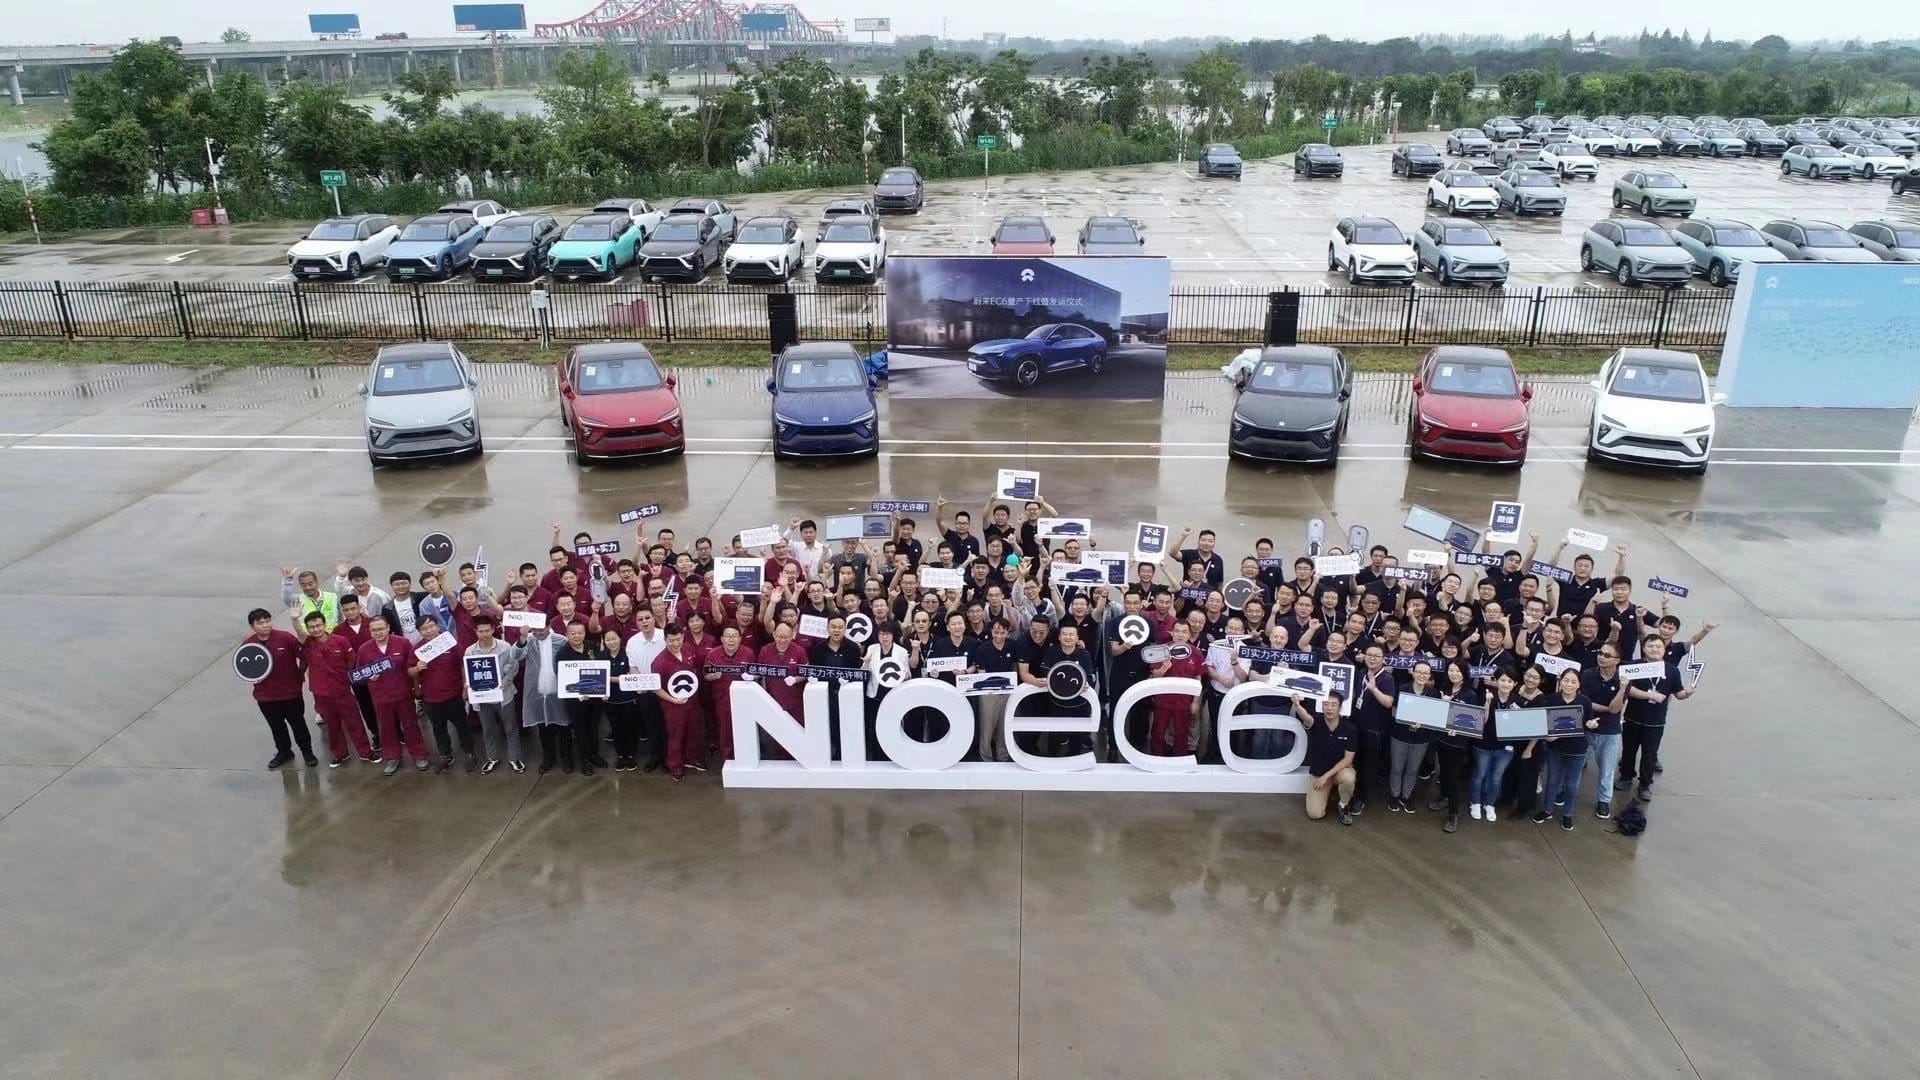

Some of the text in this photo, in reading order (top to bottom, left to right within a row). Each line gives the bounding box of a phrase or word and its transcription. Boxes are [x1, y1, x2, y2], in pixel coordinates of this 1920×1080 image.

[1182, 589, 1207, 600] 总想低
[472, 659, 492, 669] 不止
[1327, 668, 1346, 679] 不止
[730, 679, 975, 771] NIO
